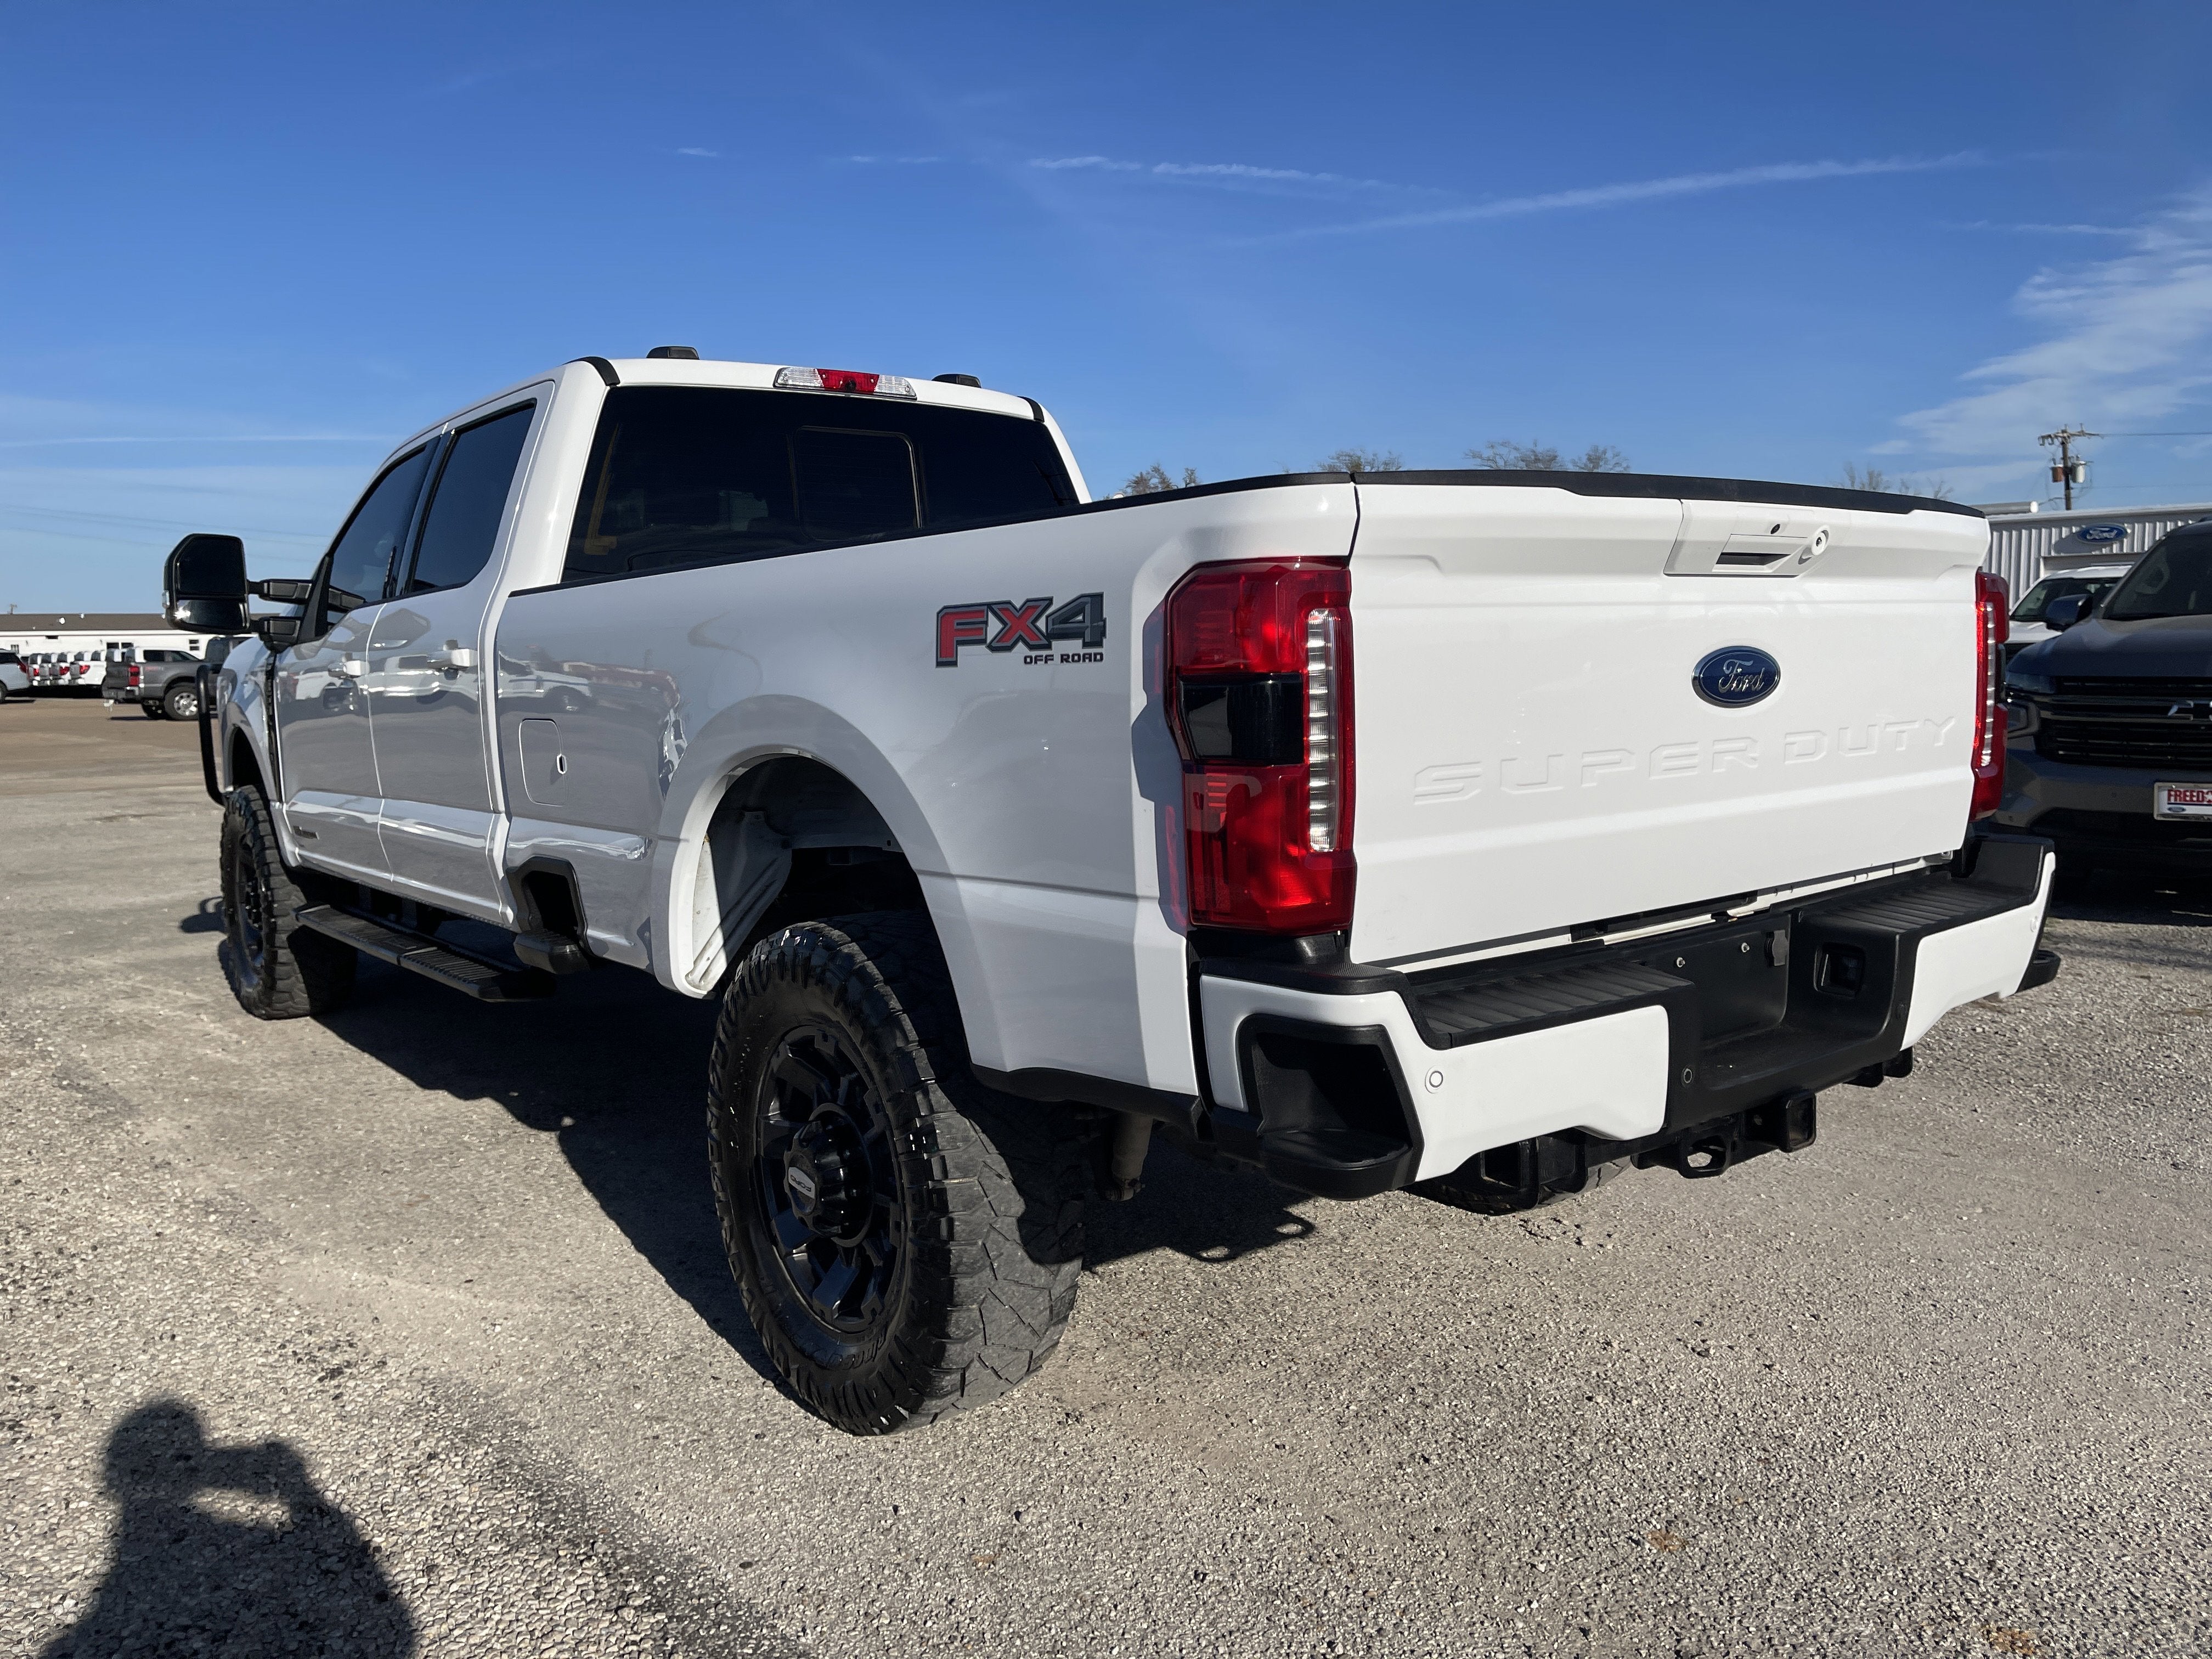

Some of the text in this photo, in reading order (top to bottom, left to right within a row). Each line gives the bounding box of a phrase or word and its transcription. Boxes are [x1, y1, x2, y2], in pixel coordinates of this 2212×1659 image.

[936, 592, 1107, 668] FX4
[1024, 652, 1104, 665] OFF ROAD
[1718, 659, 1765, 693] Ford
[1413, 716, 1957, 806] SUPER DUTY
[790, 1175, 812, 1192] FORD
